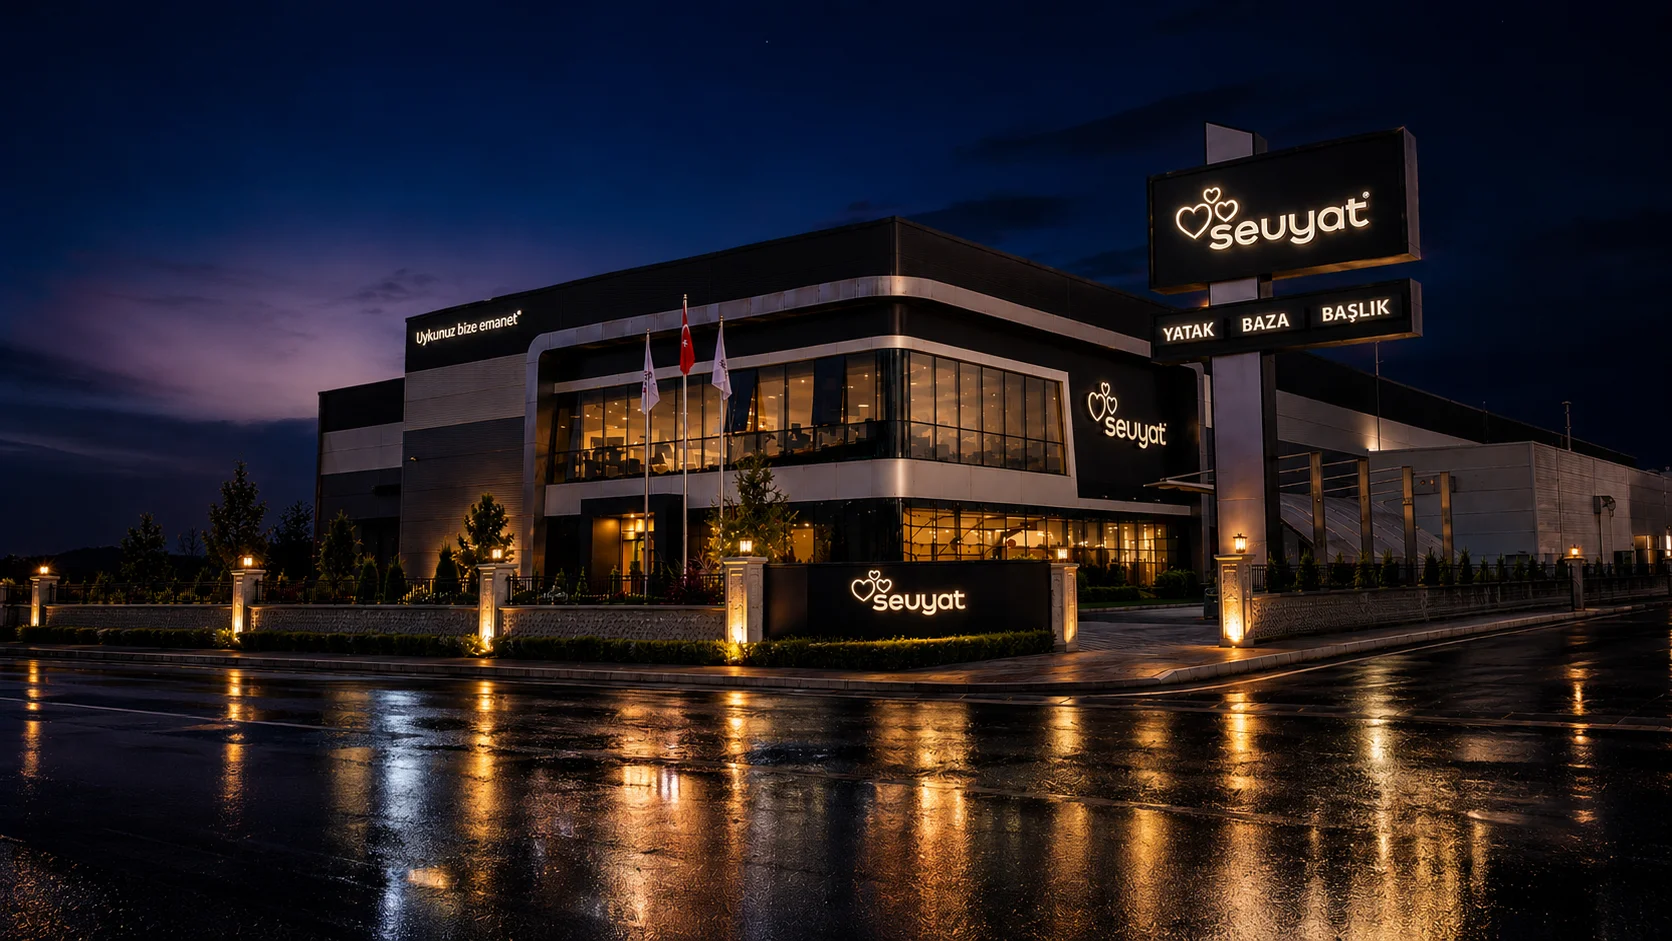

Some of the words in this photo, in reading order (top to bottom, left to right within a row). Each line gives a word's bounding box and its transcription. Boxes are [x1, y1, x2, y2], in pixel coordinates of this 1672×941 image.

[416, 327, 456, 346] Uykunuz
[457, 322, 478, 336] bize
[479, 312, 518, 331] emanet
[1163, 322, 1215, 342] YATAK
[1242, 313, 1290, 332] BAZA
[1321, 299, 1390, 323] BAŞLIK
